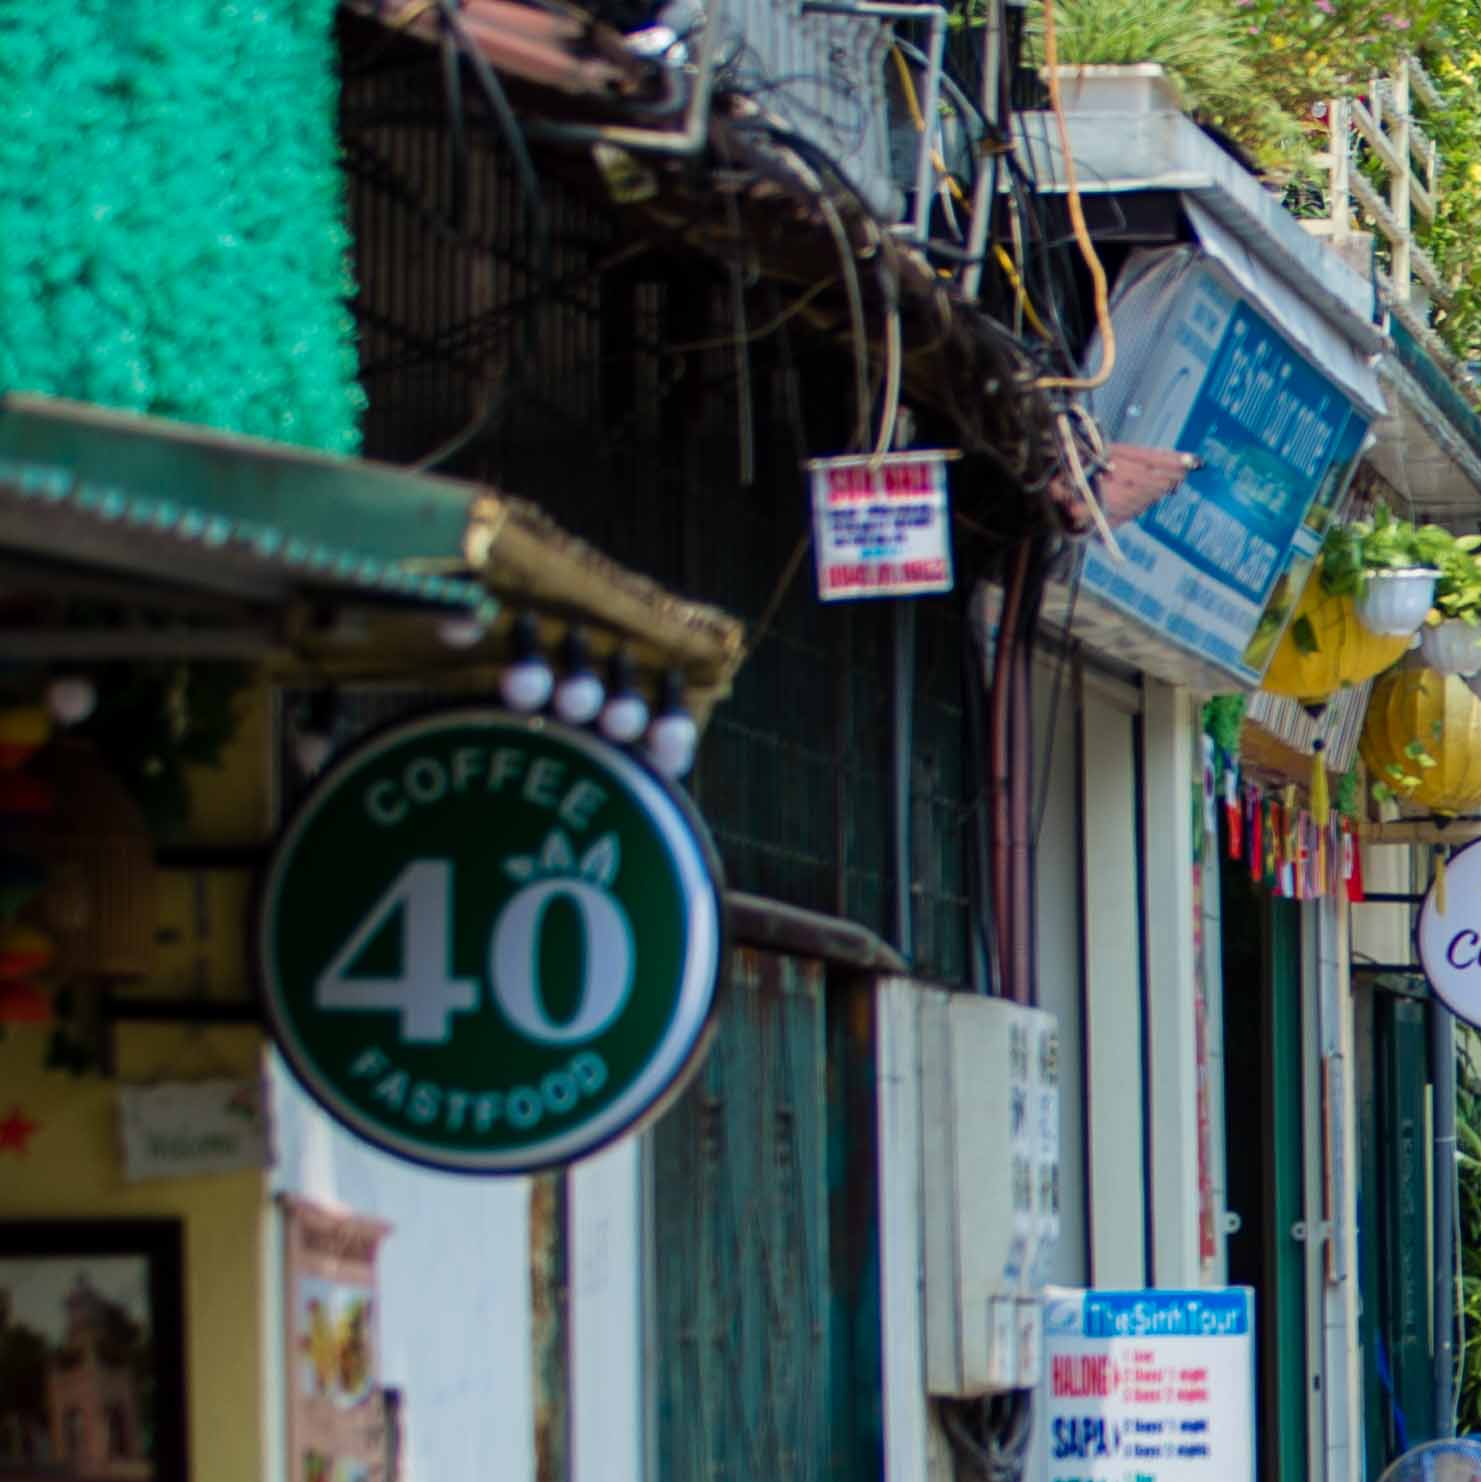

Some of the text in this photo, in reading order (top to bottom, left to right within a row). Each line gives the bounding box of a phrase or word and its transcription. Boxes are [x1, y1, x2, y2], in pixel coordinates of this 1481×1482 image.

[366, 748, 606, 828] COFFEE
[315, 857, 636, 1045] 40
[350, 1045, 608, 1133] FASTFOOD
